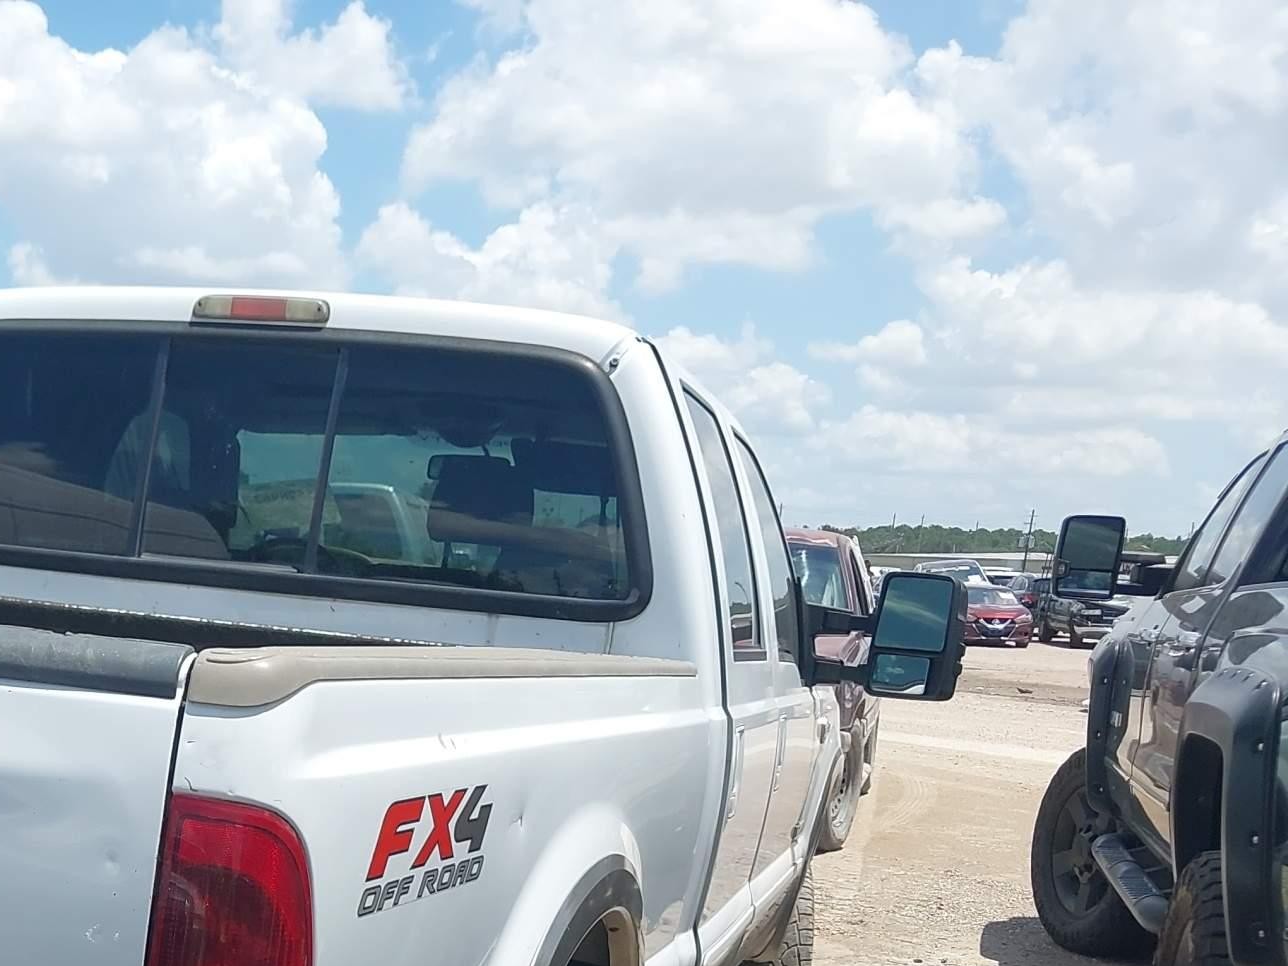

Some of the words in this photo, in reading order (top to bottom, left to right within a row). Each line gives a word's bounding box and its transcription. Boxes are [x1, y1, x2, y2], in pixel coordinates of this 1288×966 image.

[365, 784, 493, 882] FX4
[357, 875, 414, 917] OFF
[418, 855, 484, 899] ROAD
